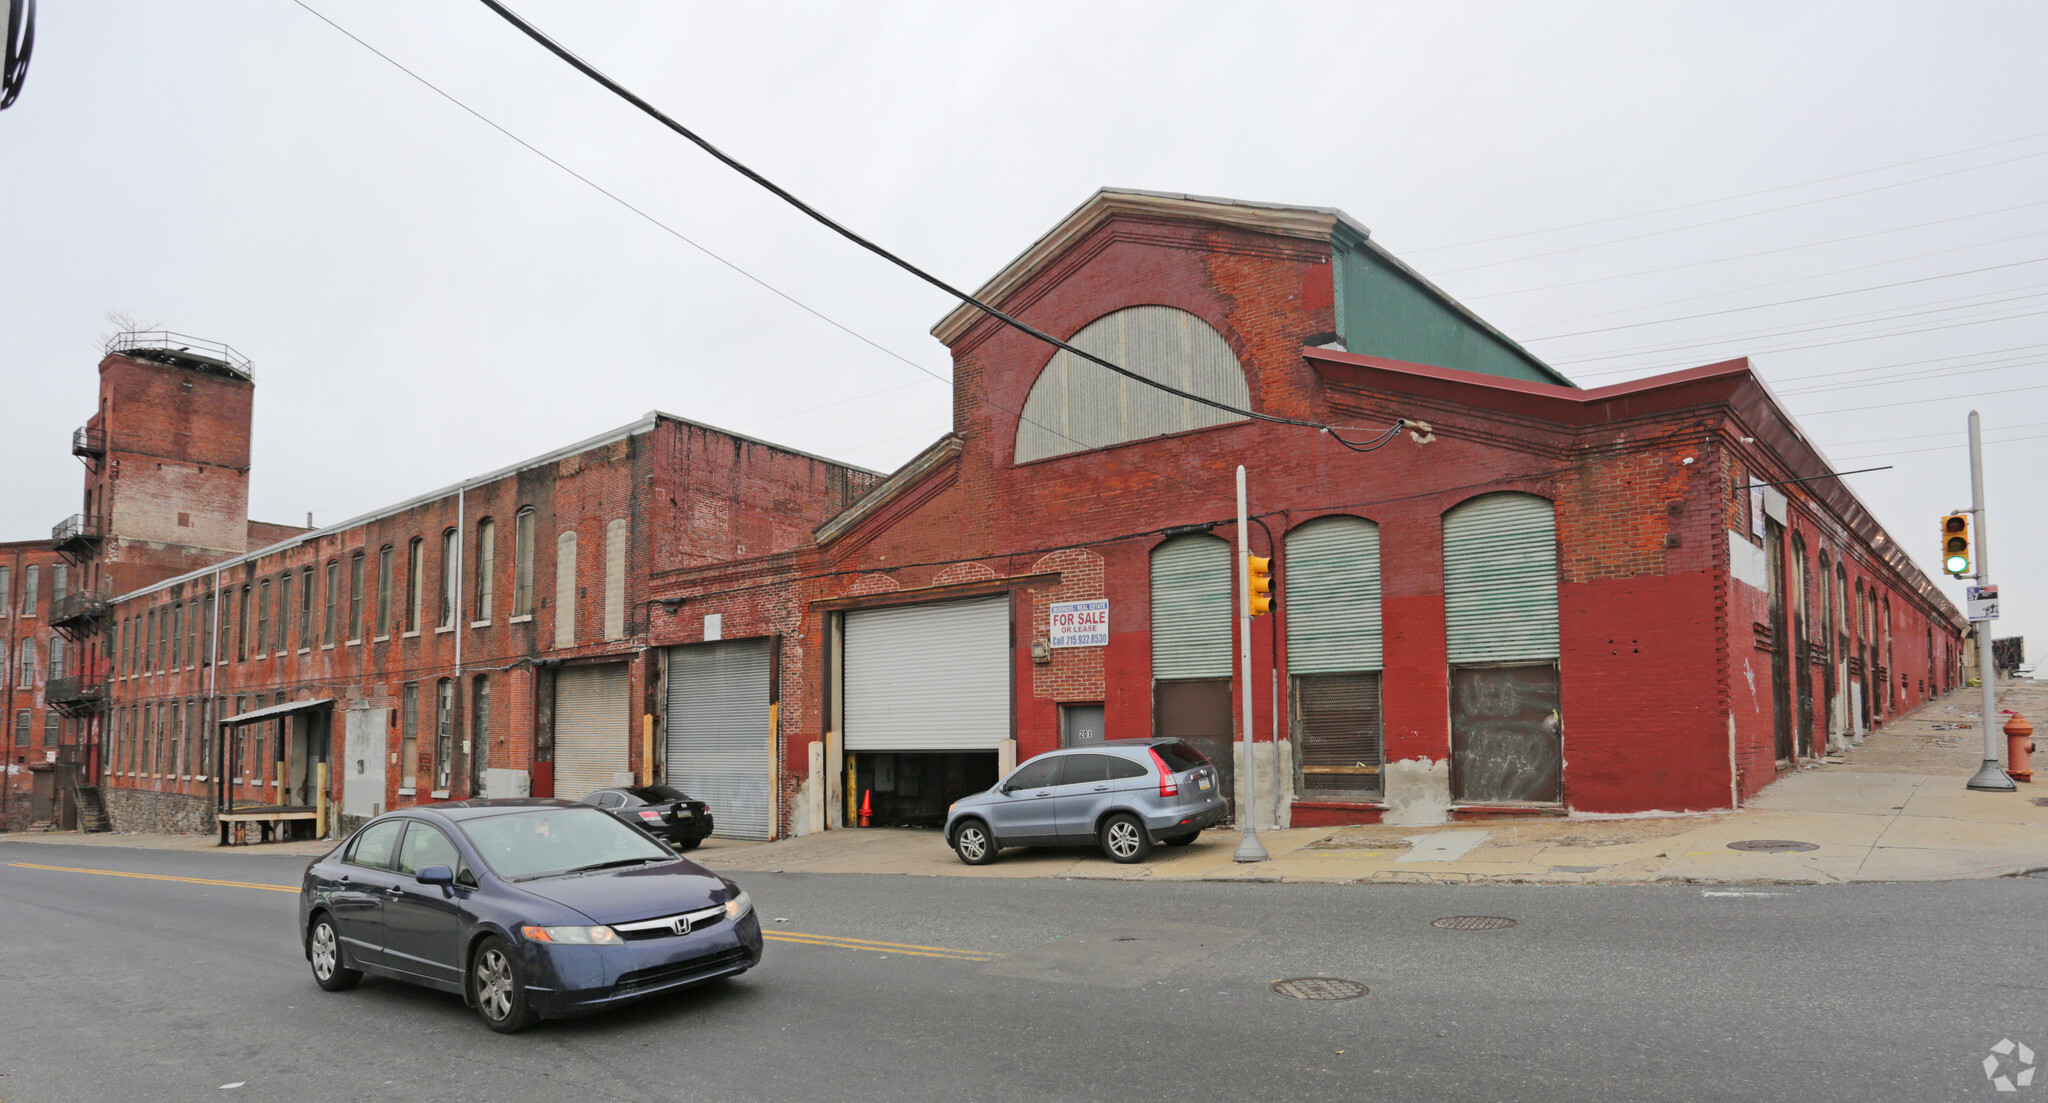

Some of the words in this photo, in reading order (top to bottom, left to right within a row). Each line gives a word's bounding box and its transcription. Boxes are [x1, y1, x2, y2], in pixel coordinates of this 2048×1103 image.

[1053, 613, 1074, 626] FOR
[1078, 611, 1106, 625] SALE
[1052, 636, 1064, 646] Call
[1066, 633, 1107, 645] 215.932.8530
[1079, 730, 1092, 738] 201
